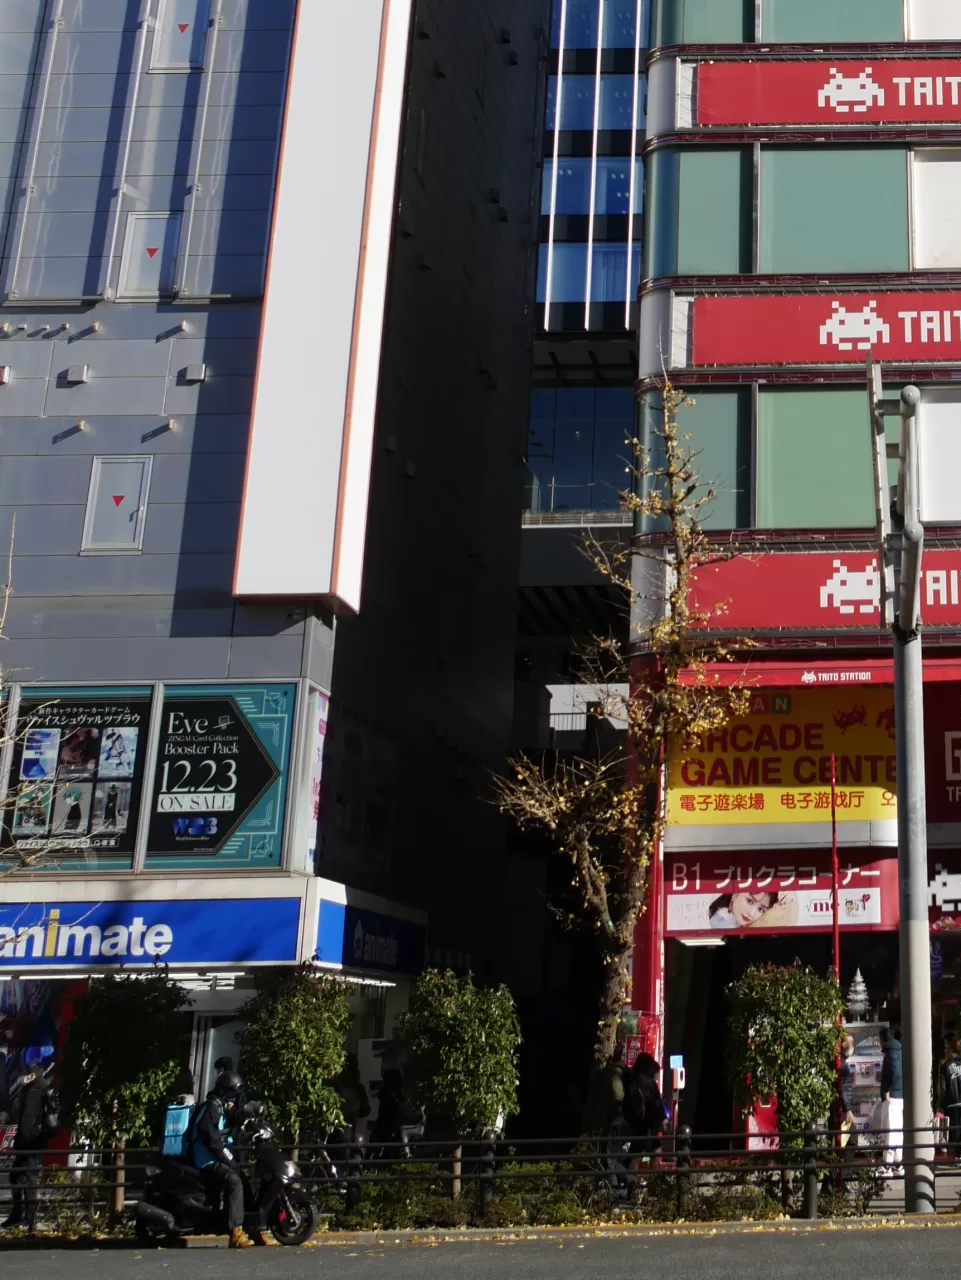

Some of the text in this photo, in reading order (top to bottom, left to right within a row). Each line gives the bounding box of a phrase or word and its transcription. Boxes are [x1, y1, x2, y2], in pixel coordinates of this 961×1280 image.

[818, 671, 871, 682] TAITO STATION
[167, 712, 209, 734] Eve
[164, 742, 239, 755] Booster Pack
[160, 759, 238, 793] 12.23
[681, 754, 897, 787] GAME CENTE
[160, 795, 232, 811] ON SALE
[680, 793, 765, 812] 電子遊楽場
[672, 861, 881, 891] B1 プリクラコーナー
[0, 909, 173, 958] animate
